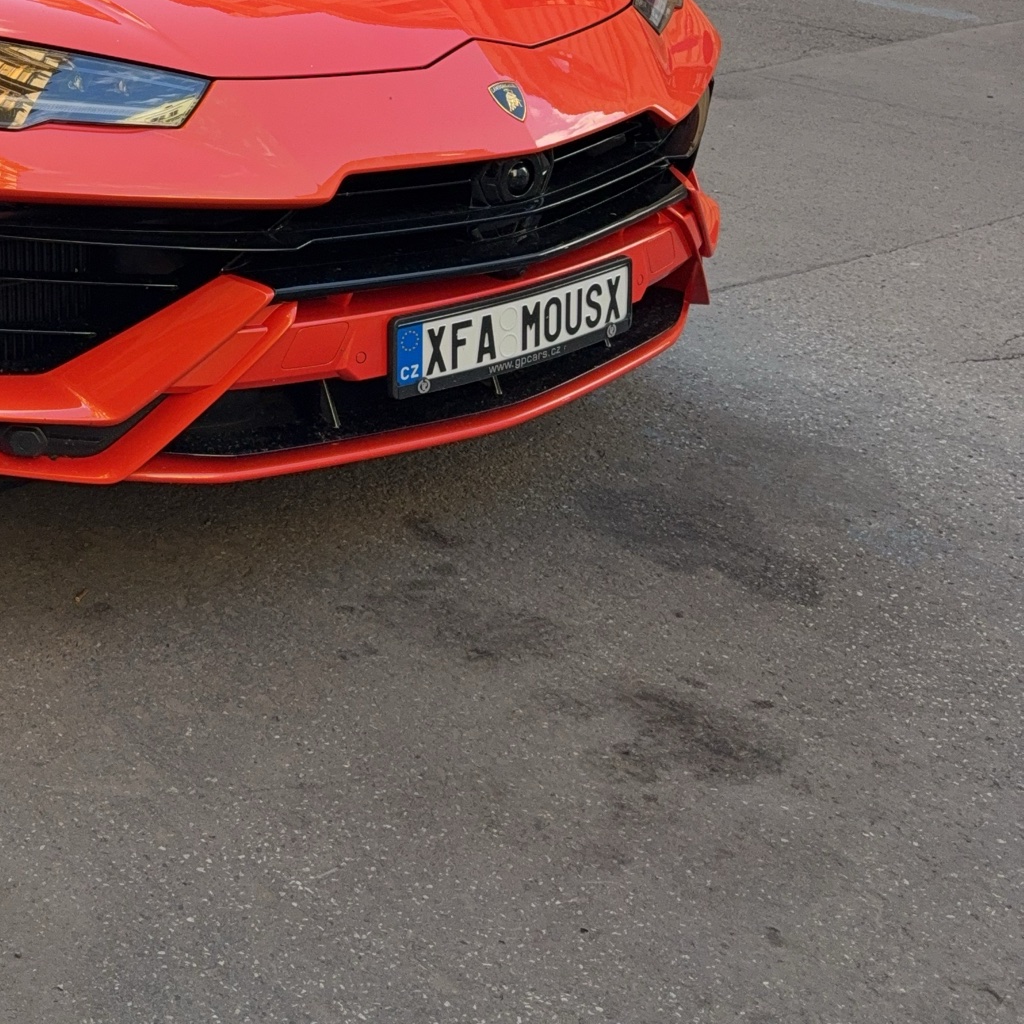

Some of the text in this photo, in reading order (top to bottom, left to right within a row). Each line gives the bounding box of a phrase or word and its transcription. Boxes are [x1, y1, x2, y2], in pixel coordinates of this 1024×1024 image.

[426, 314, 497, 376] XFA
[488, 345, 562, 374] www.gpcars.cz
[400, 363, 419, 381] CZ
